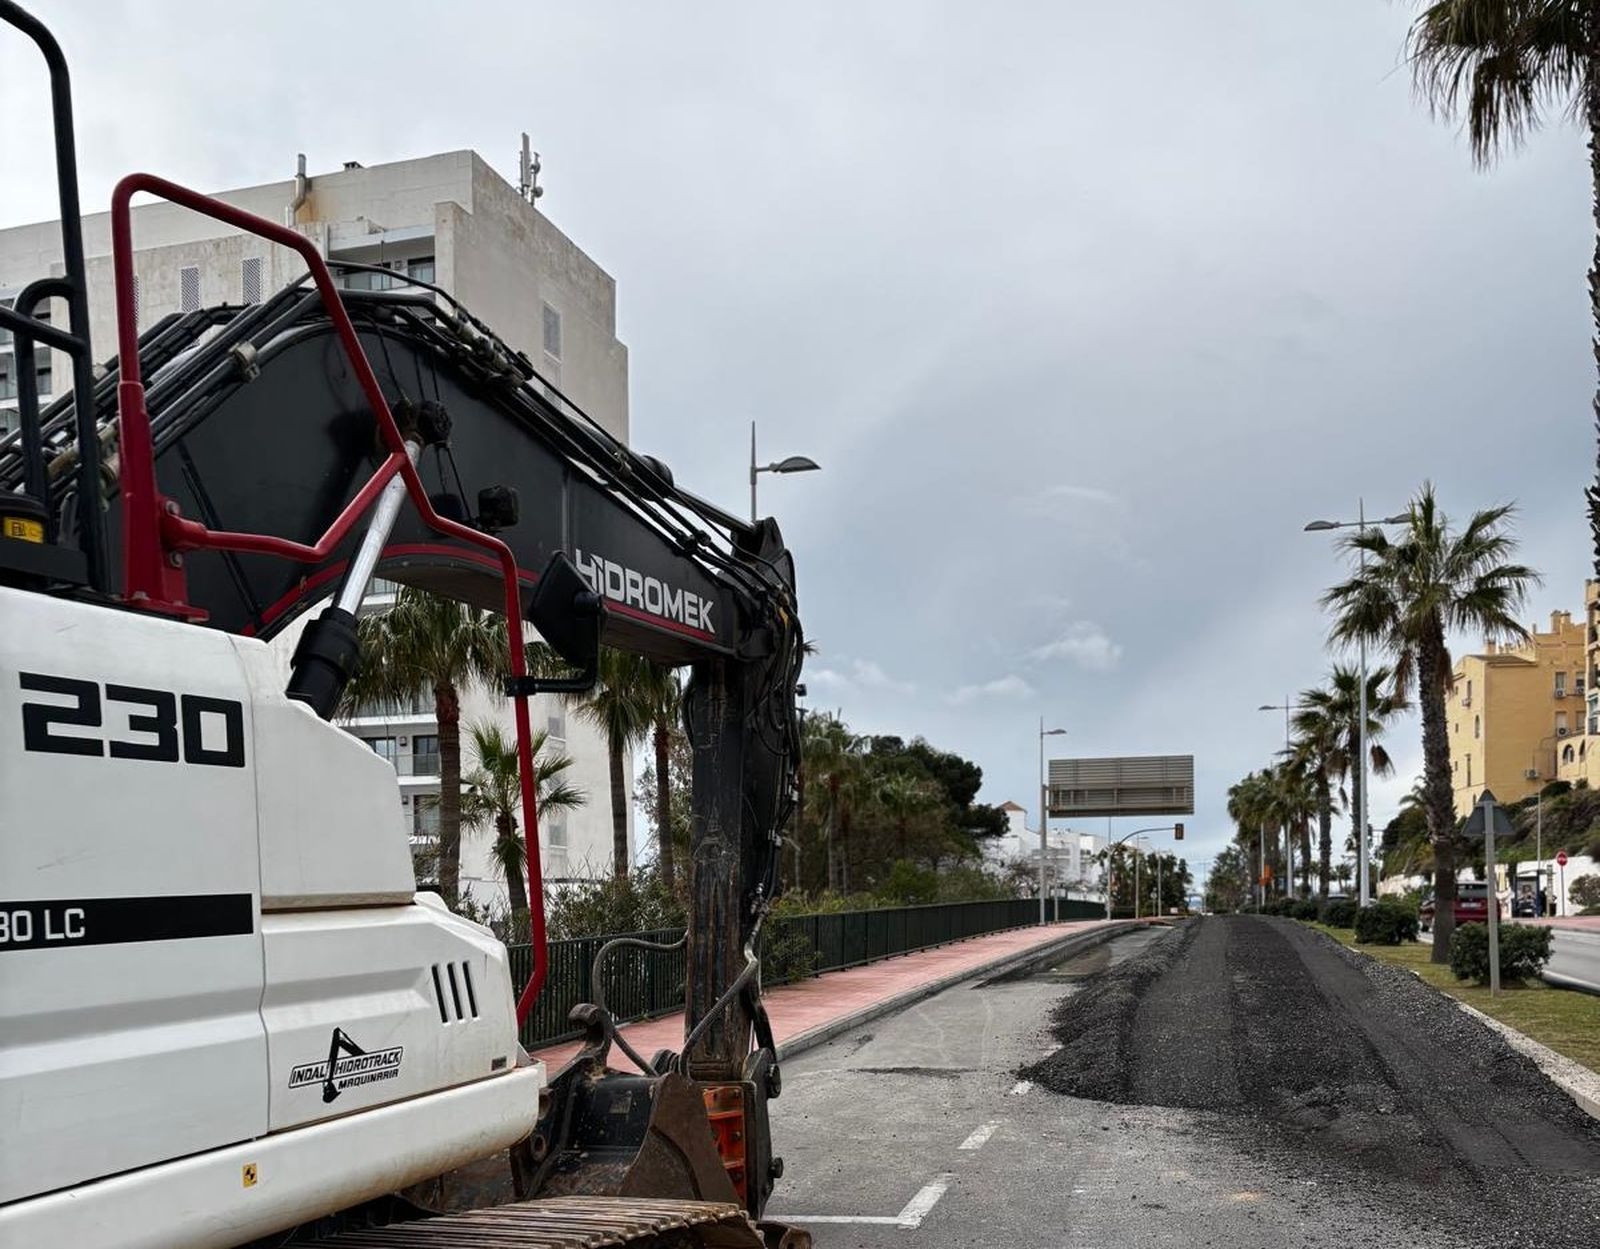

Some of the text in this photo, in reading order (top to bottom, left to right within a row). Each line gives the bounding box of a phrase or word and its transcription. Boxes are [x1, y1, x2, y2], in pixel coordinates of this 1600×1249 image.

[19, 671, 245, 768] 230
[44, 908, 85, 939] LC
[291, 1051, 400, 1084] INDAL HIDROTRACK
[338, 1069, 399, 1089] MAQUINARIA
